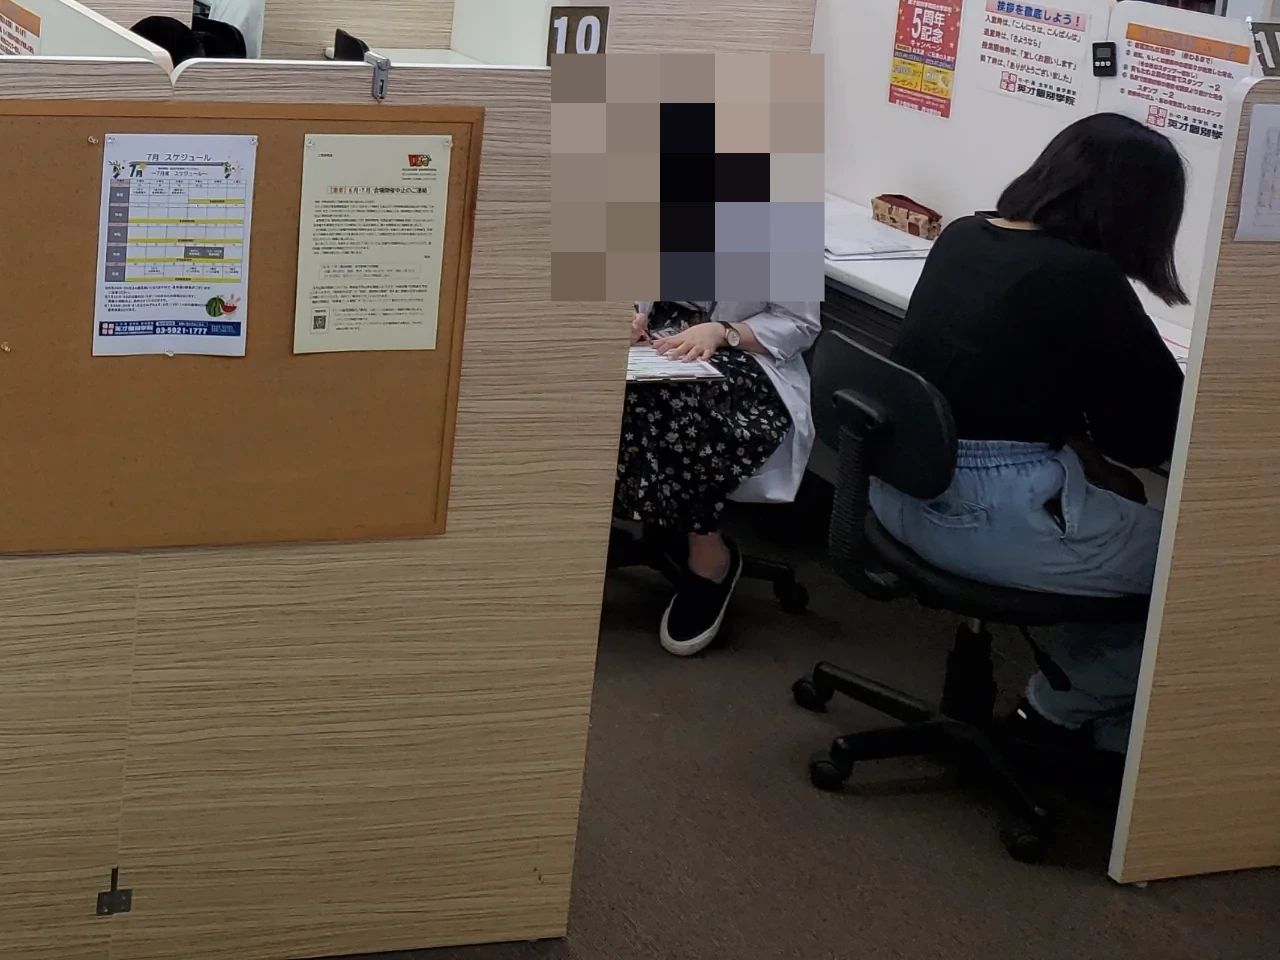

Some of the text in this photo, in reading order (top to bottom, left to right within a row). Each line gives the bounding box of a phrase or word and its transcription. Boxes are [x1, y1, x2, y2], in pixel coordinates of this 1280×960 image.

[911, 7, 946, 39] 5 周年
[996, 0, 1081, 27] 挨拶を徹底しよう！
[553, 15, 600, 54] 10
[920, 25, 944, 44] 記念
[1017, 83, 1076, 106] 英才個別学院
[146, 153, 212, 162] 7月 スケジュール
